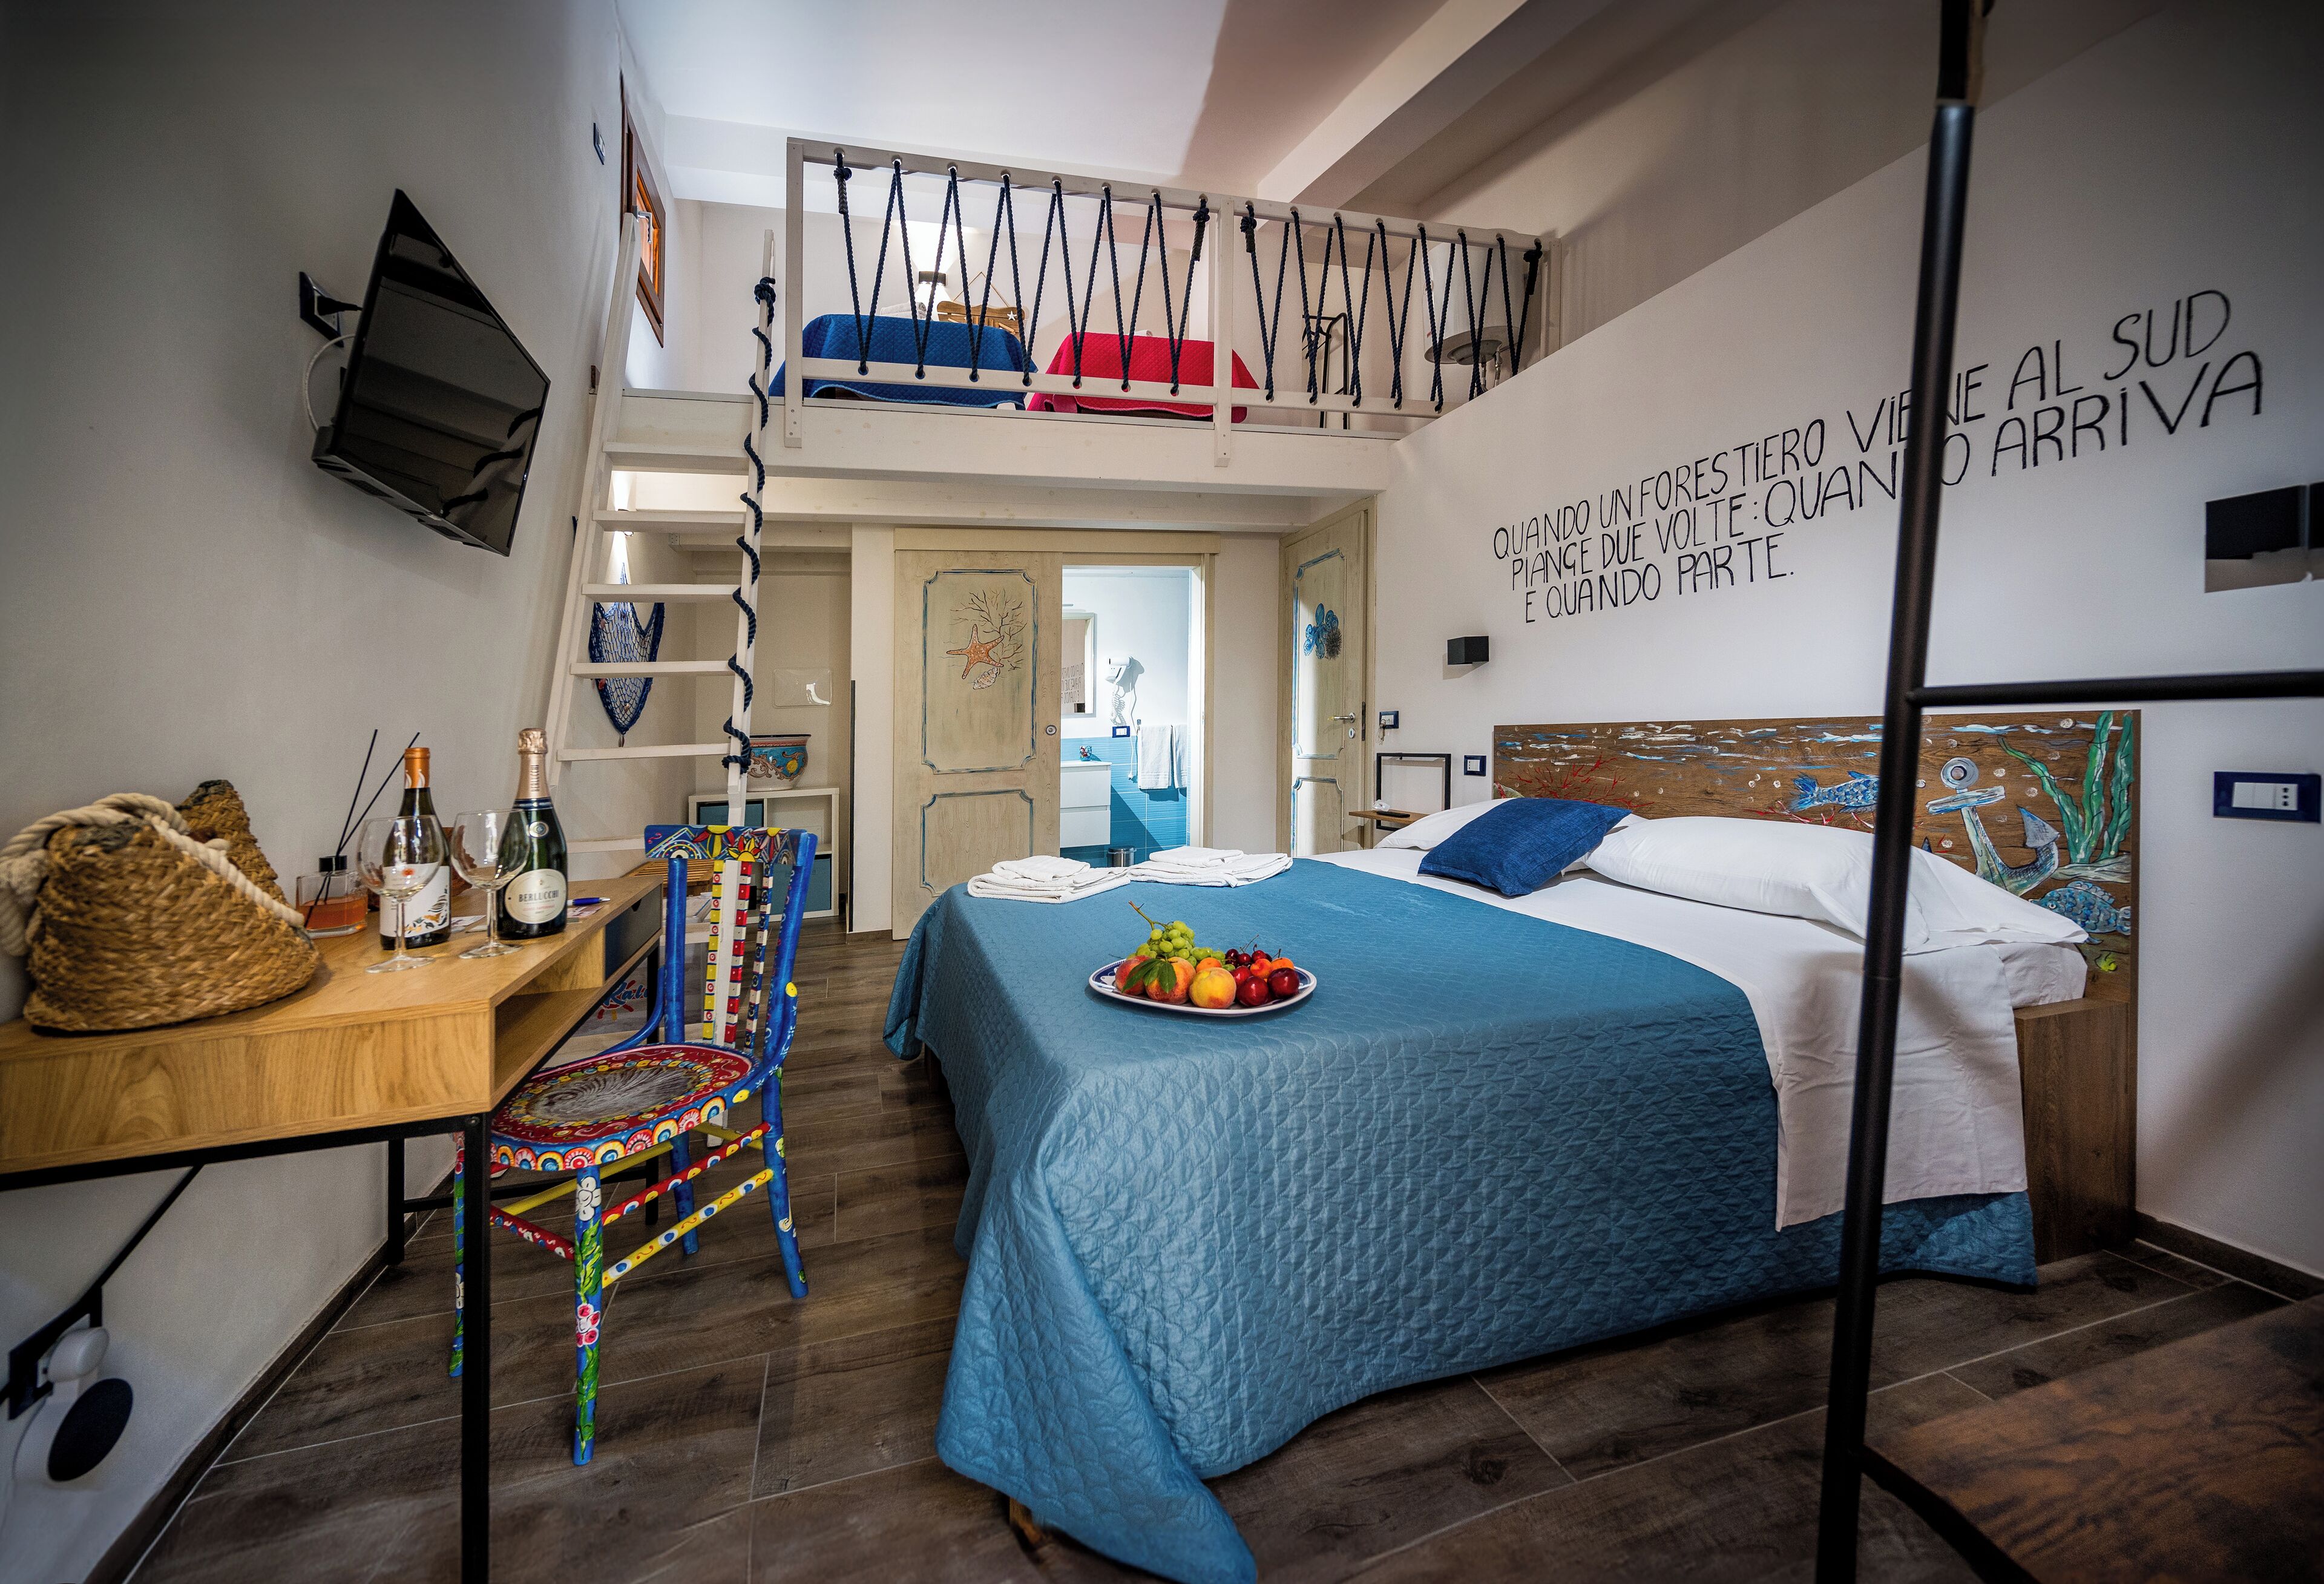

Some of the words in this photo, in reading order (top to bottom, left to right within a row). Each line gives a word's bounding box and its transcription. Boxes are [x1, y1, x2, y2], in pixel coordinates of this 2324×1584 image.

[1493, 499, 1590, 560] QUANDO
[1600, 484, 1632, 529] UN
[2007, 339, 2084, 411] AL
[2104, 289, 2231, 381] SUD
[1601, 521, 1646, 570] DUE
[1764, 432, 1971, 527] QUANO
[1525, 590, 1537, 623] E
[1546, 563, 1661, 619] QUANDO
[1678, 532, 1794, 596] PARTE.
[518, 890, 559, 902] BERLUCCHI
